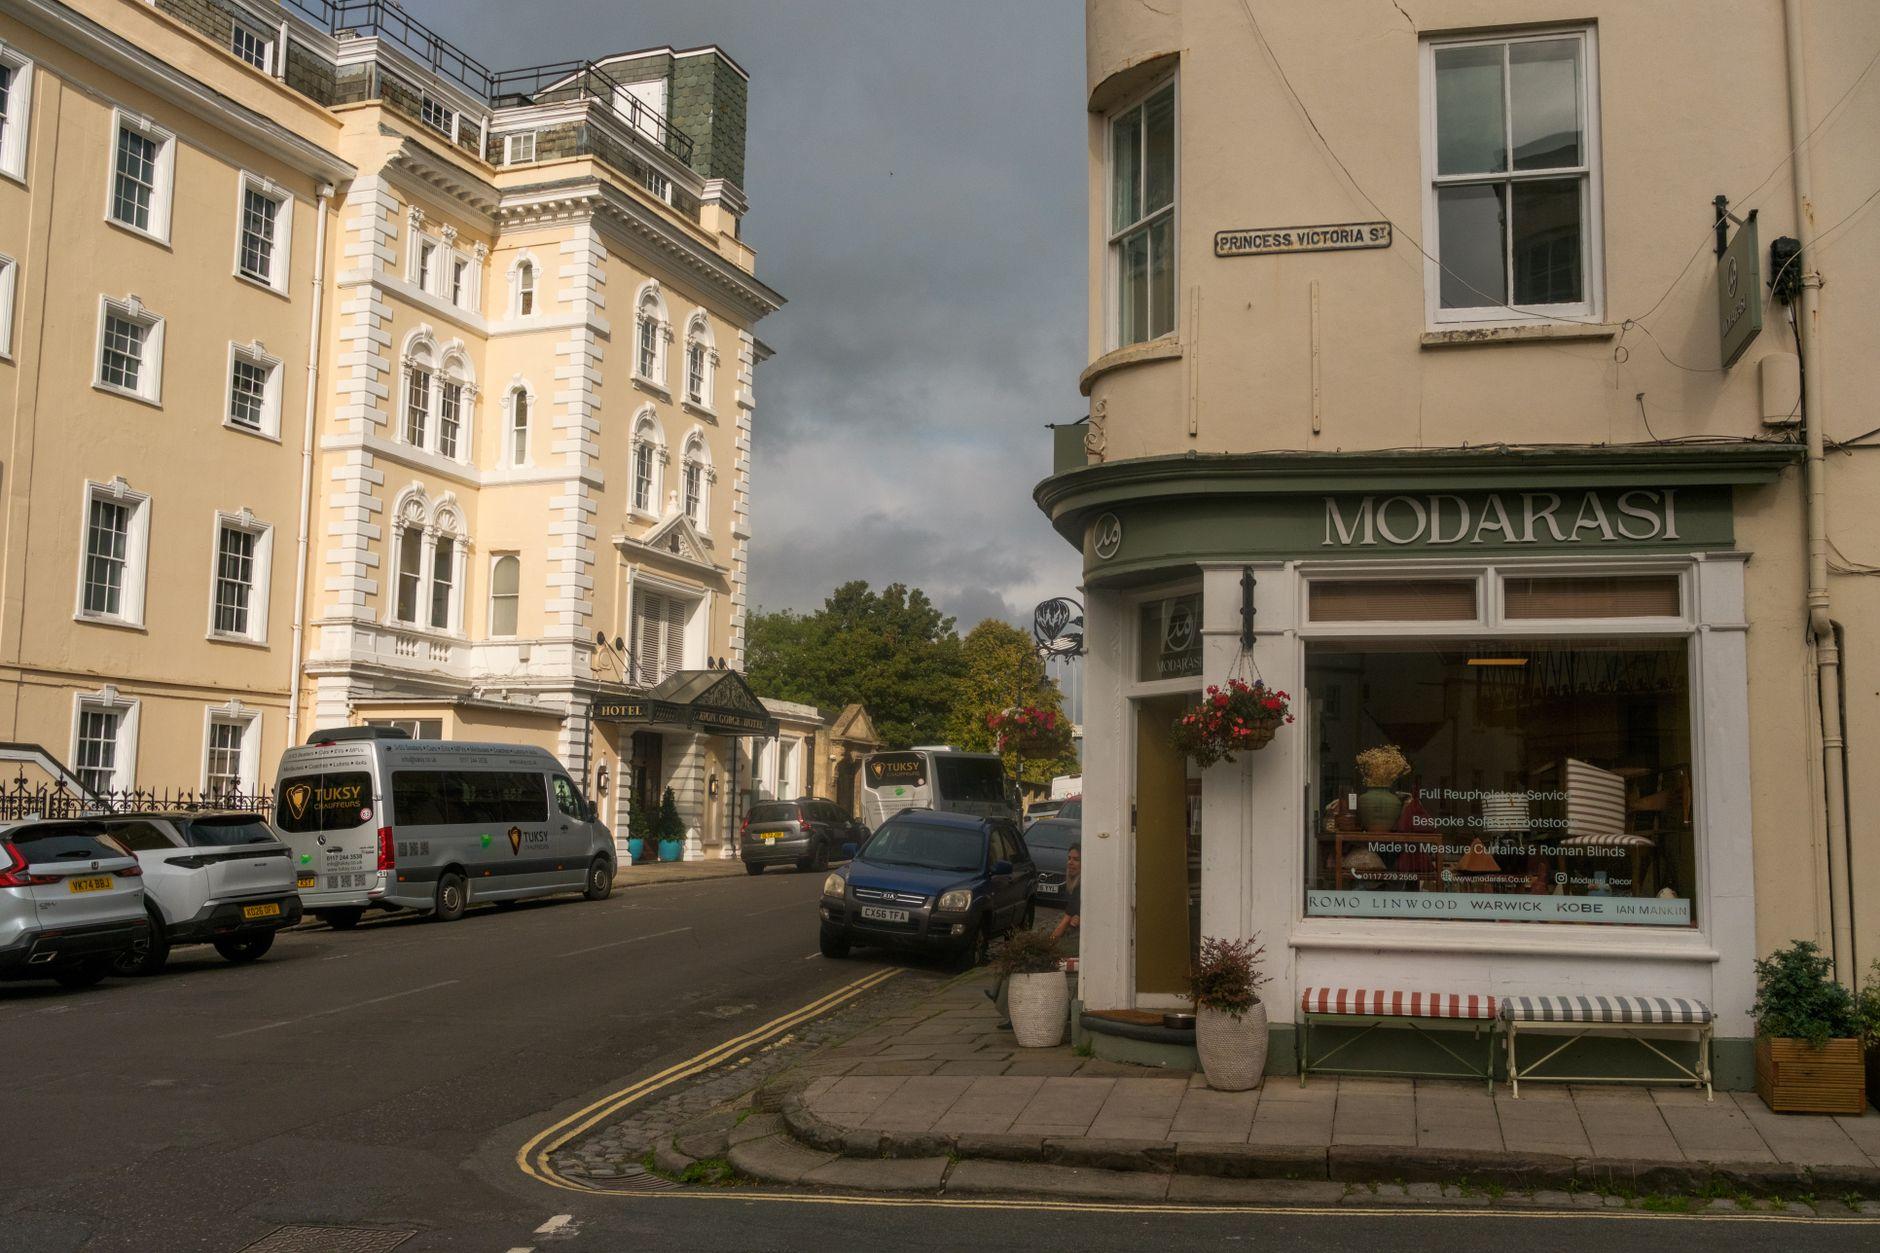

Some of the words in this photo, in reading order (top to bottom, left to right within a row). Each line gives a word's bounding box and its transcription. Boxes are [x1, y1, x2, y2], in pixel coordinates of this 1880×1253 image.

[1219, 233, 1292, 251] PRINCESS
[1297, 227, 1364, 246] VICTORIA
[1322, 488, 1681, 545] MODARASI
[1157, 656, 1203, 673] MODARASI
[601, 705, 643, 716] HOTEL
[886, 762, 920, 771] TUKSY
[314, 786, 361, 801] TUKSY
[1419, 788, 1441, 801] Full
[1443, 788, 1525, 804] Reupholstery
[1526, 790, 1572, 801] Service
[1412, 815, 1466, 829] Bespoke
[1467, 815, 1498, 828] Sofas
[523, 831, 549, 843] TUKSY
[1368, 841, 1401, 853] Made
[1403, 842, 1417, 853] to
[1419, 842, 1471, 855] Measure
[1473, 843, 1525, 856] Curtains
[1528, 844, 1537, 856] &
[1540, 845, 1584, 857] Roman
[1587, 845, 1626, 858] Blinds
[1362, 872, 1382, 881] 0117
[72, 880, 94, 892] VK74
[95, 878, 110, 889] BBJ
[1309, 896, 1361, 909] ROMO
[1372, 898, 1458, 910] LINWOOD
[1470, 900, 1542, 912] WARWICK
[1556, 902, 1604, 913] KOBE
[1616, 905, 1635, 915] IAN
[1639, 906, 1688, 916] MANKIN
[864, 907, 887, 919] CX56
[888, 910, 905, 921] TFA
